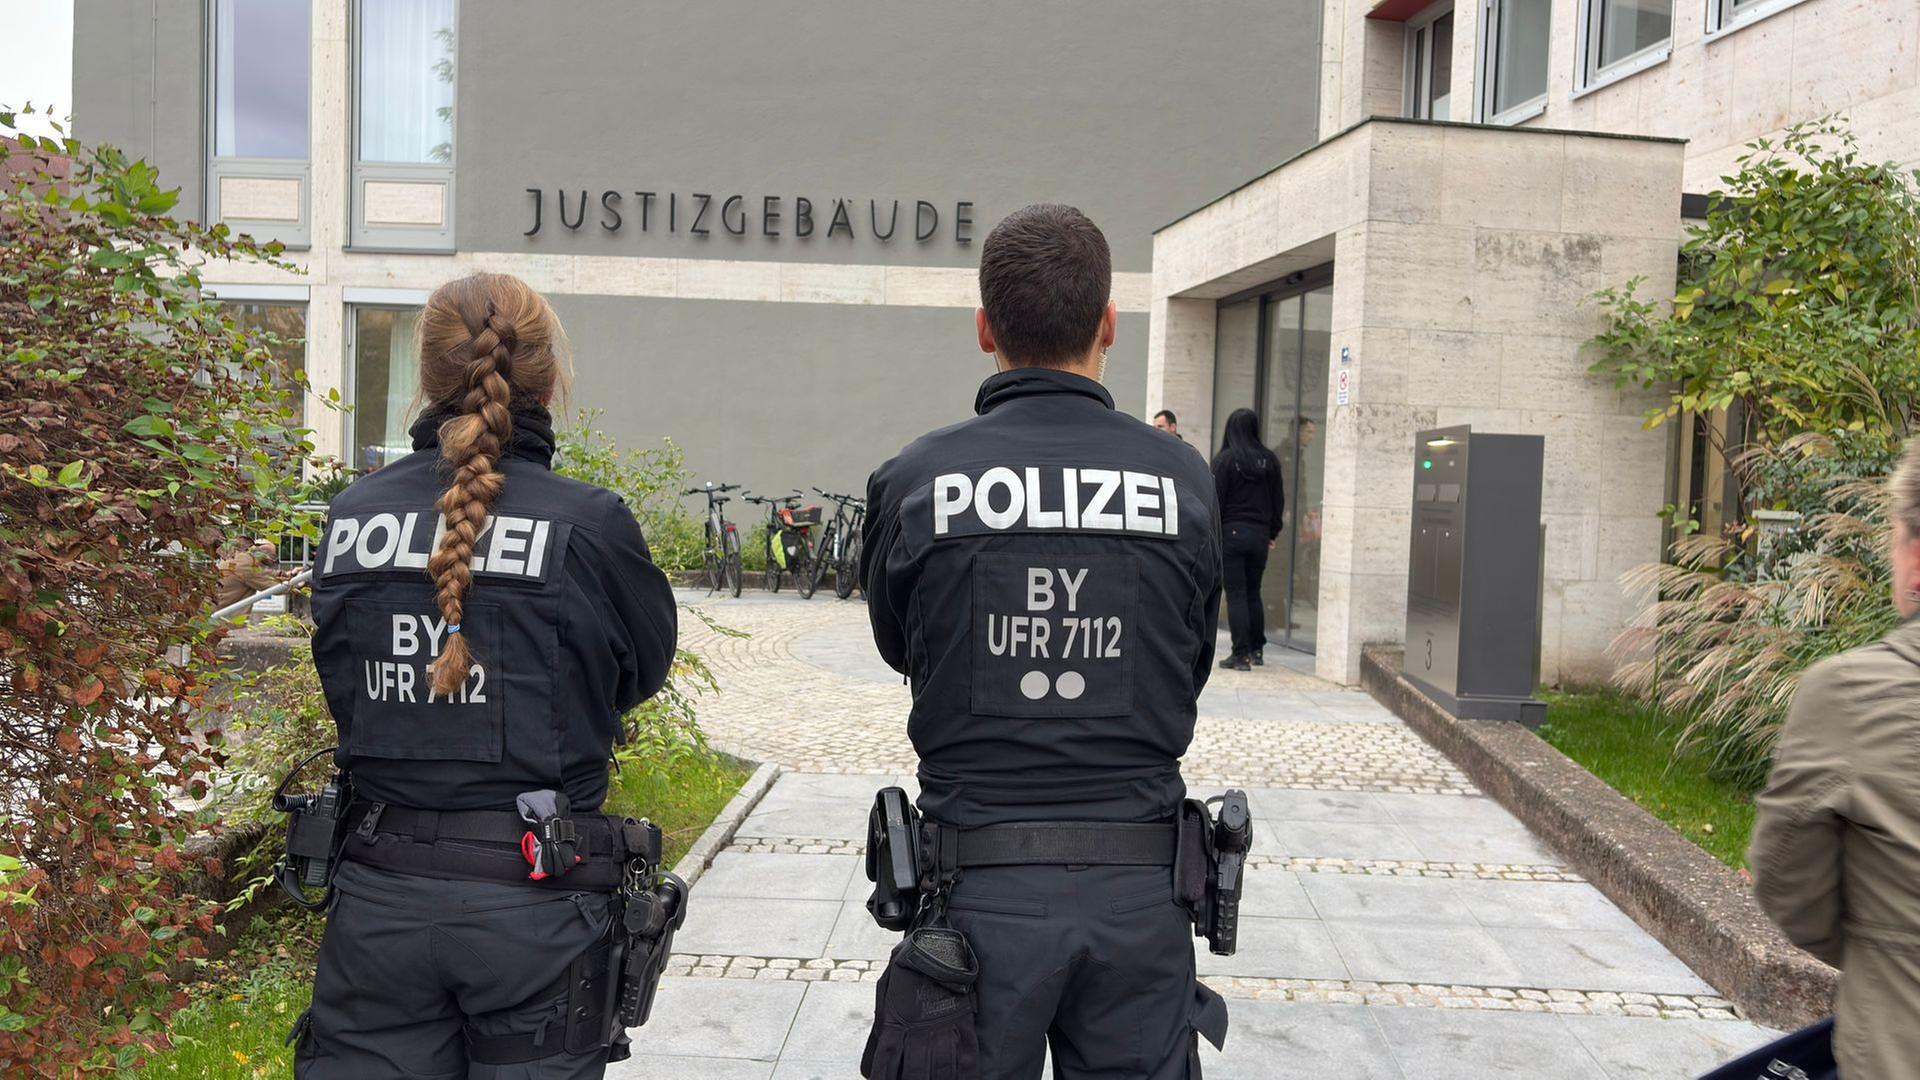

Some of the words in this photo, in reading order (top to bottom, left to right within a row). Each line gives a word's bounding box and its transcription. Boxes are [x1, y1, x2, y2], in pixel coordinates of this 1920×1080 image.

[523, 188, 974, 243] JUSTIZGEBÄUDE
[934, 466, 1179, 535] POLIZEI
[1027, 567, 1089, 612] BY
[392, 614, 447, 657] BY
[988, 614, 1051, 659] UFR
[1061, 616, 1122, 659] 7112
[1424, 638, 1433, 672] 3
[365, 660, 416, 704] UFR
